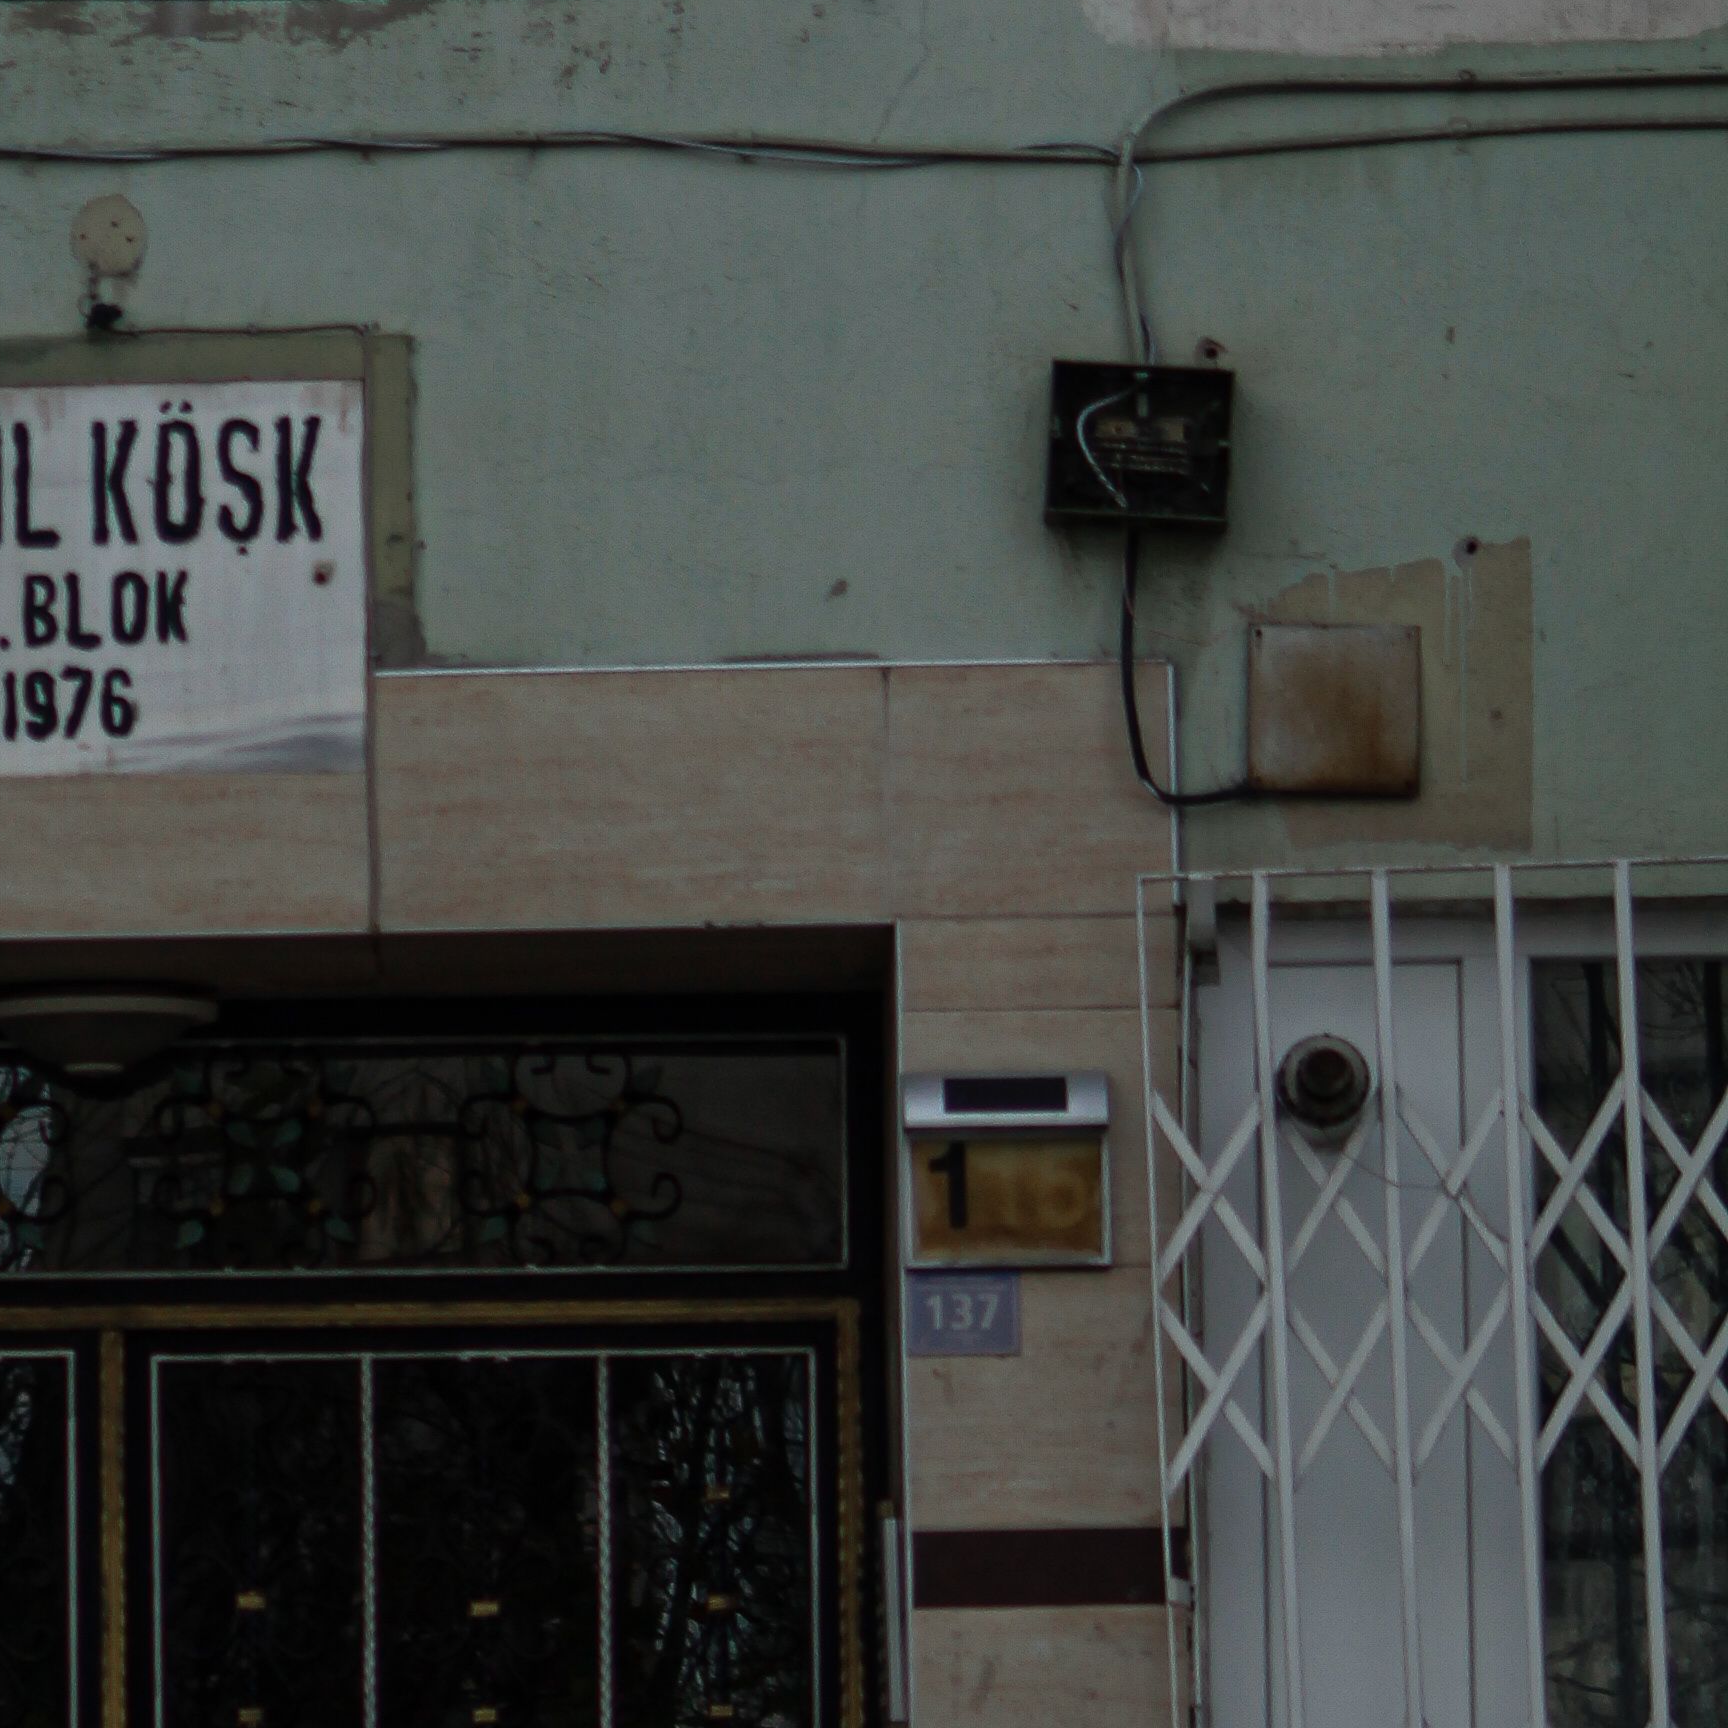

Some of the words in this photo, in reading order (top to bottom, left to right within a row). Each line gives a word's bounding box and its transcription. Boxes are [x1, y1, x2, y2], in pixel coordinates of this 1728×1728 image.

[91, 400, 324, 556] KÖŞK
[2, 666, 138, 741] 1976
[926, 1293, 1000, 1331] 137
